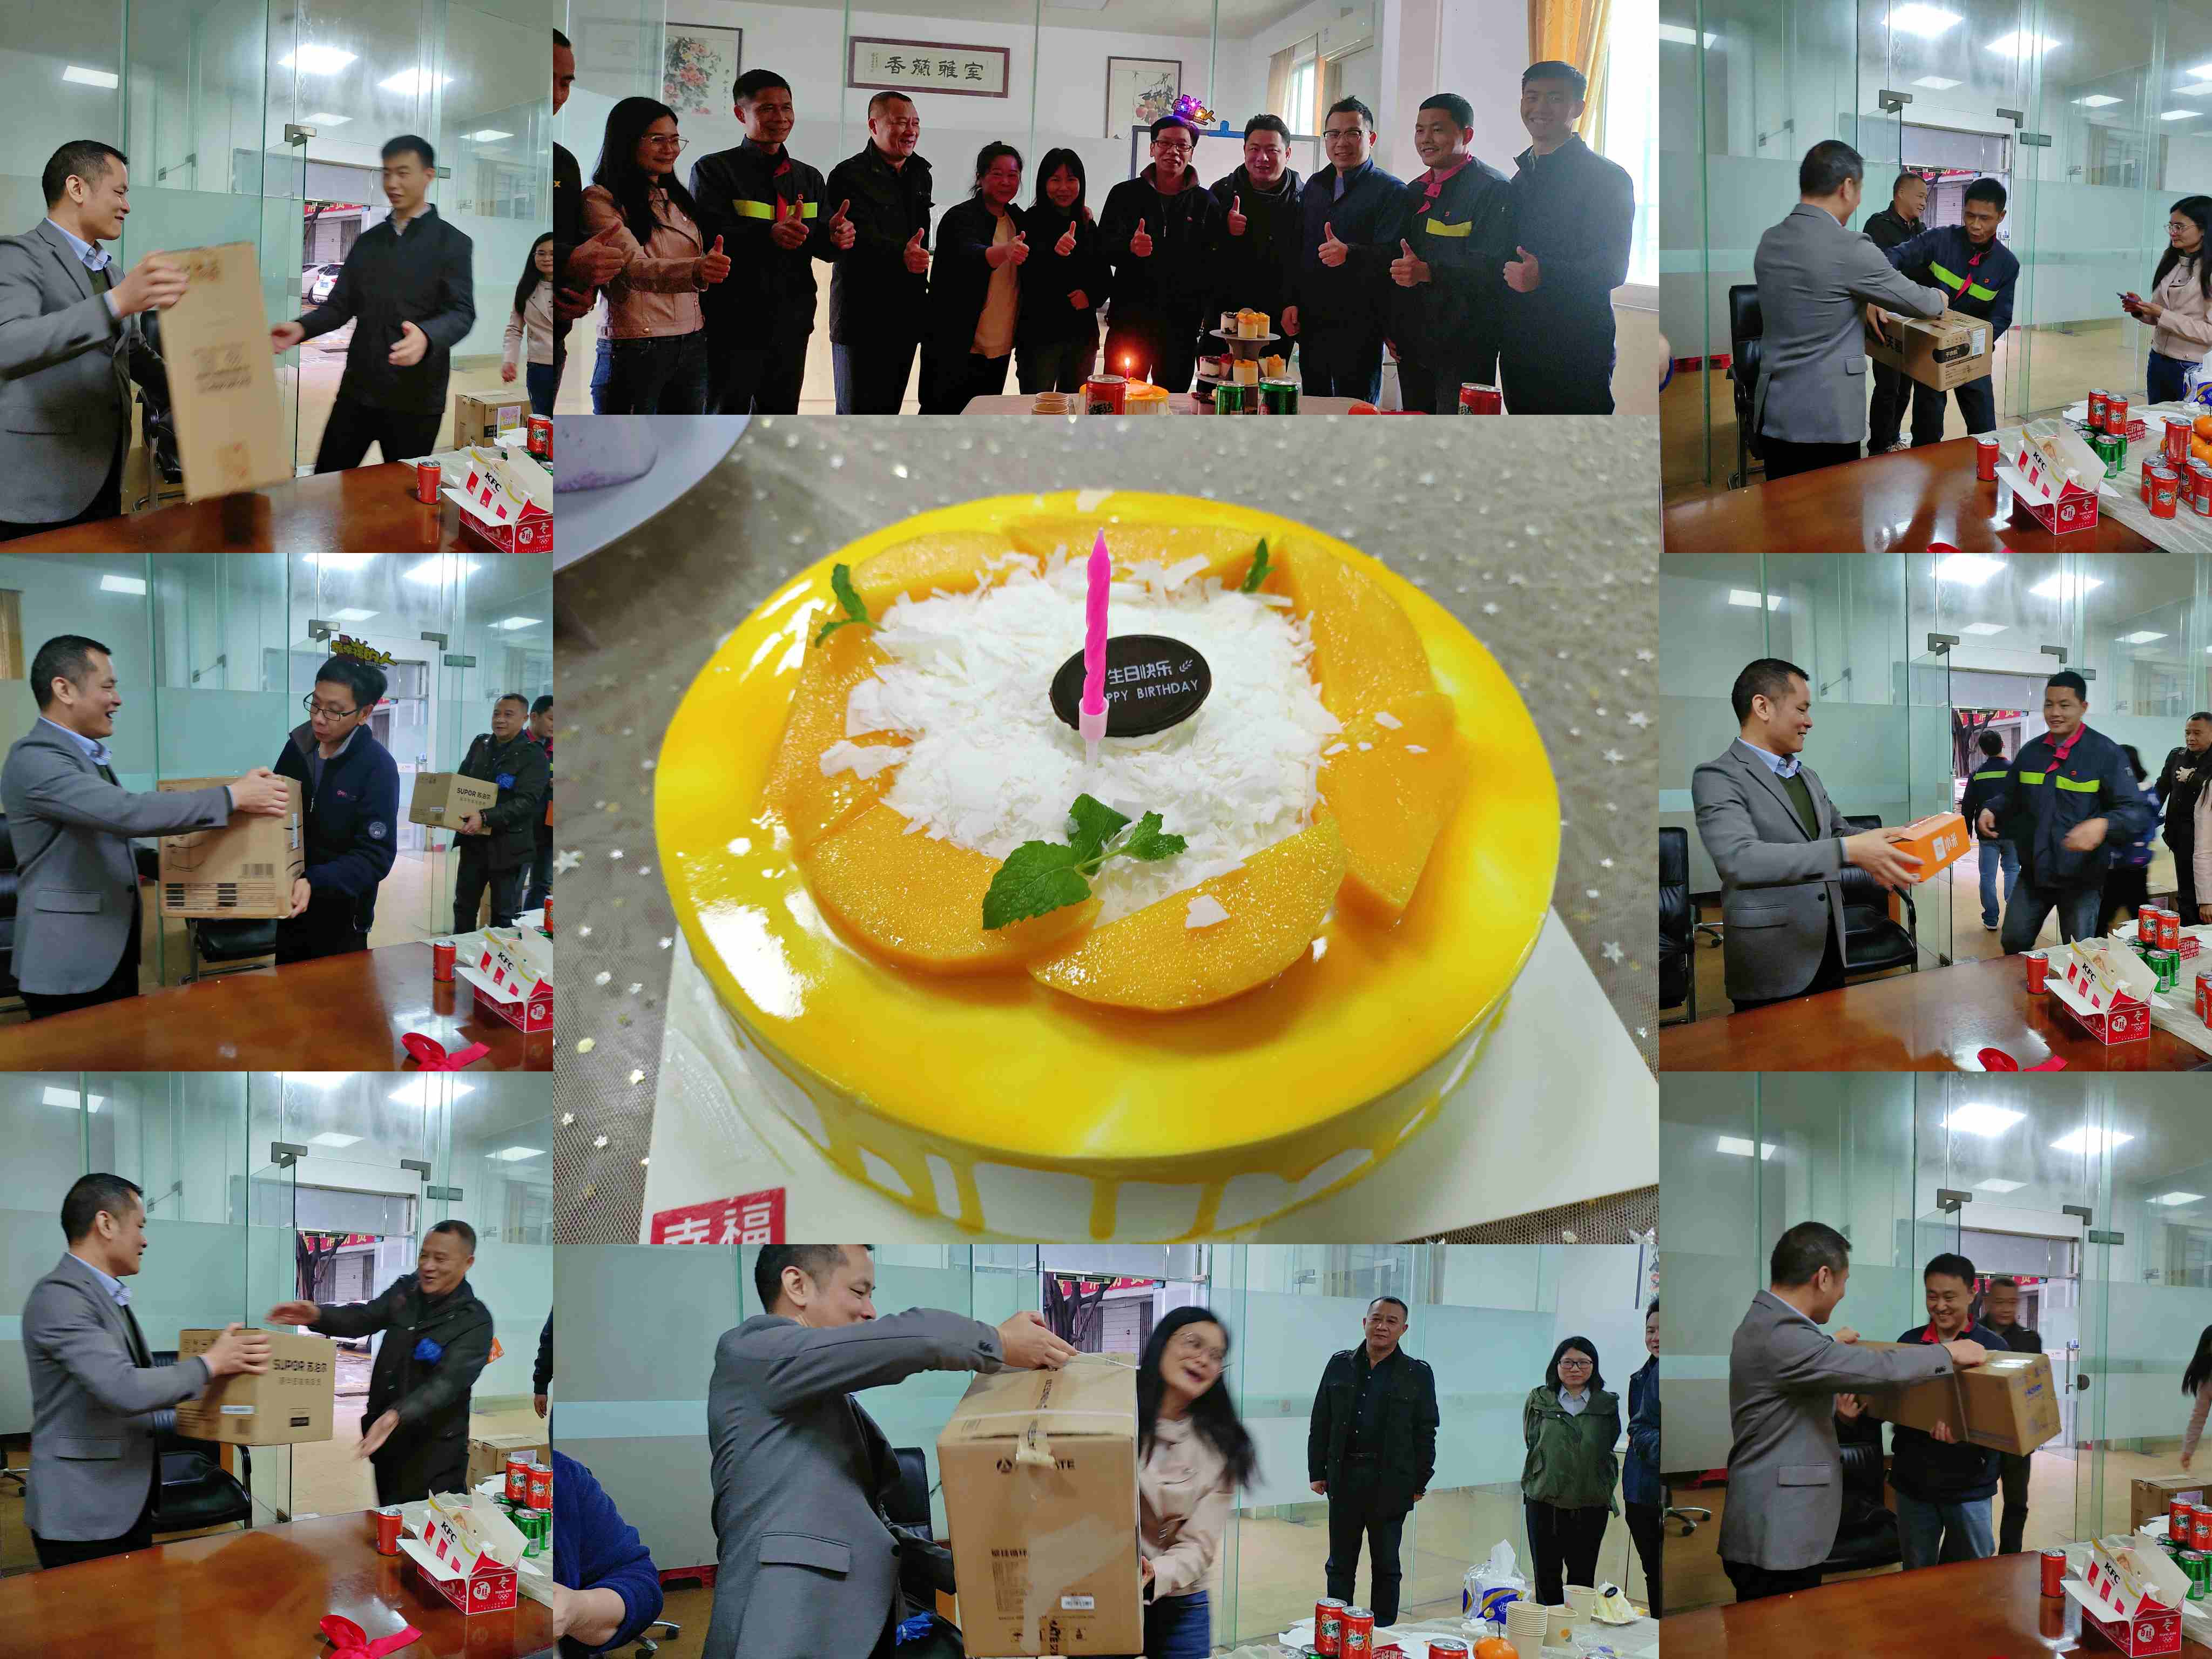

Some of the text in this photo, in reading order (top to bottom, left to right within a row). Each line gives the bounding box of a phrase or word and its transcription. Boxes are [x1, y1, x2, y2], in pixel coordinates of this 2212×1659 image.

[2033, 451, 2047, 471] KFC
[484, 471, 502, 492] KFC
[1108, 660, 1172, 685] 生日快乐
[1107, 679, 1198, 703] PPY BIRTHDAY
[457, 787, 476, 797] SUPOR
[497, 952, 514, 971] KFC
[2082, 962, 2096, 982] KFC
[441, 1521, 457, 1543] KFC
[2104, 1562, 2120, 1584] KFC
